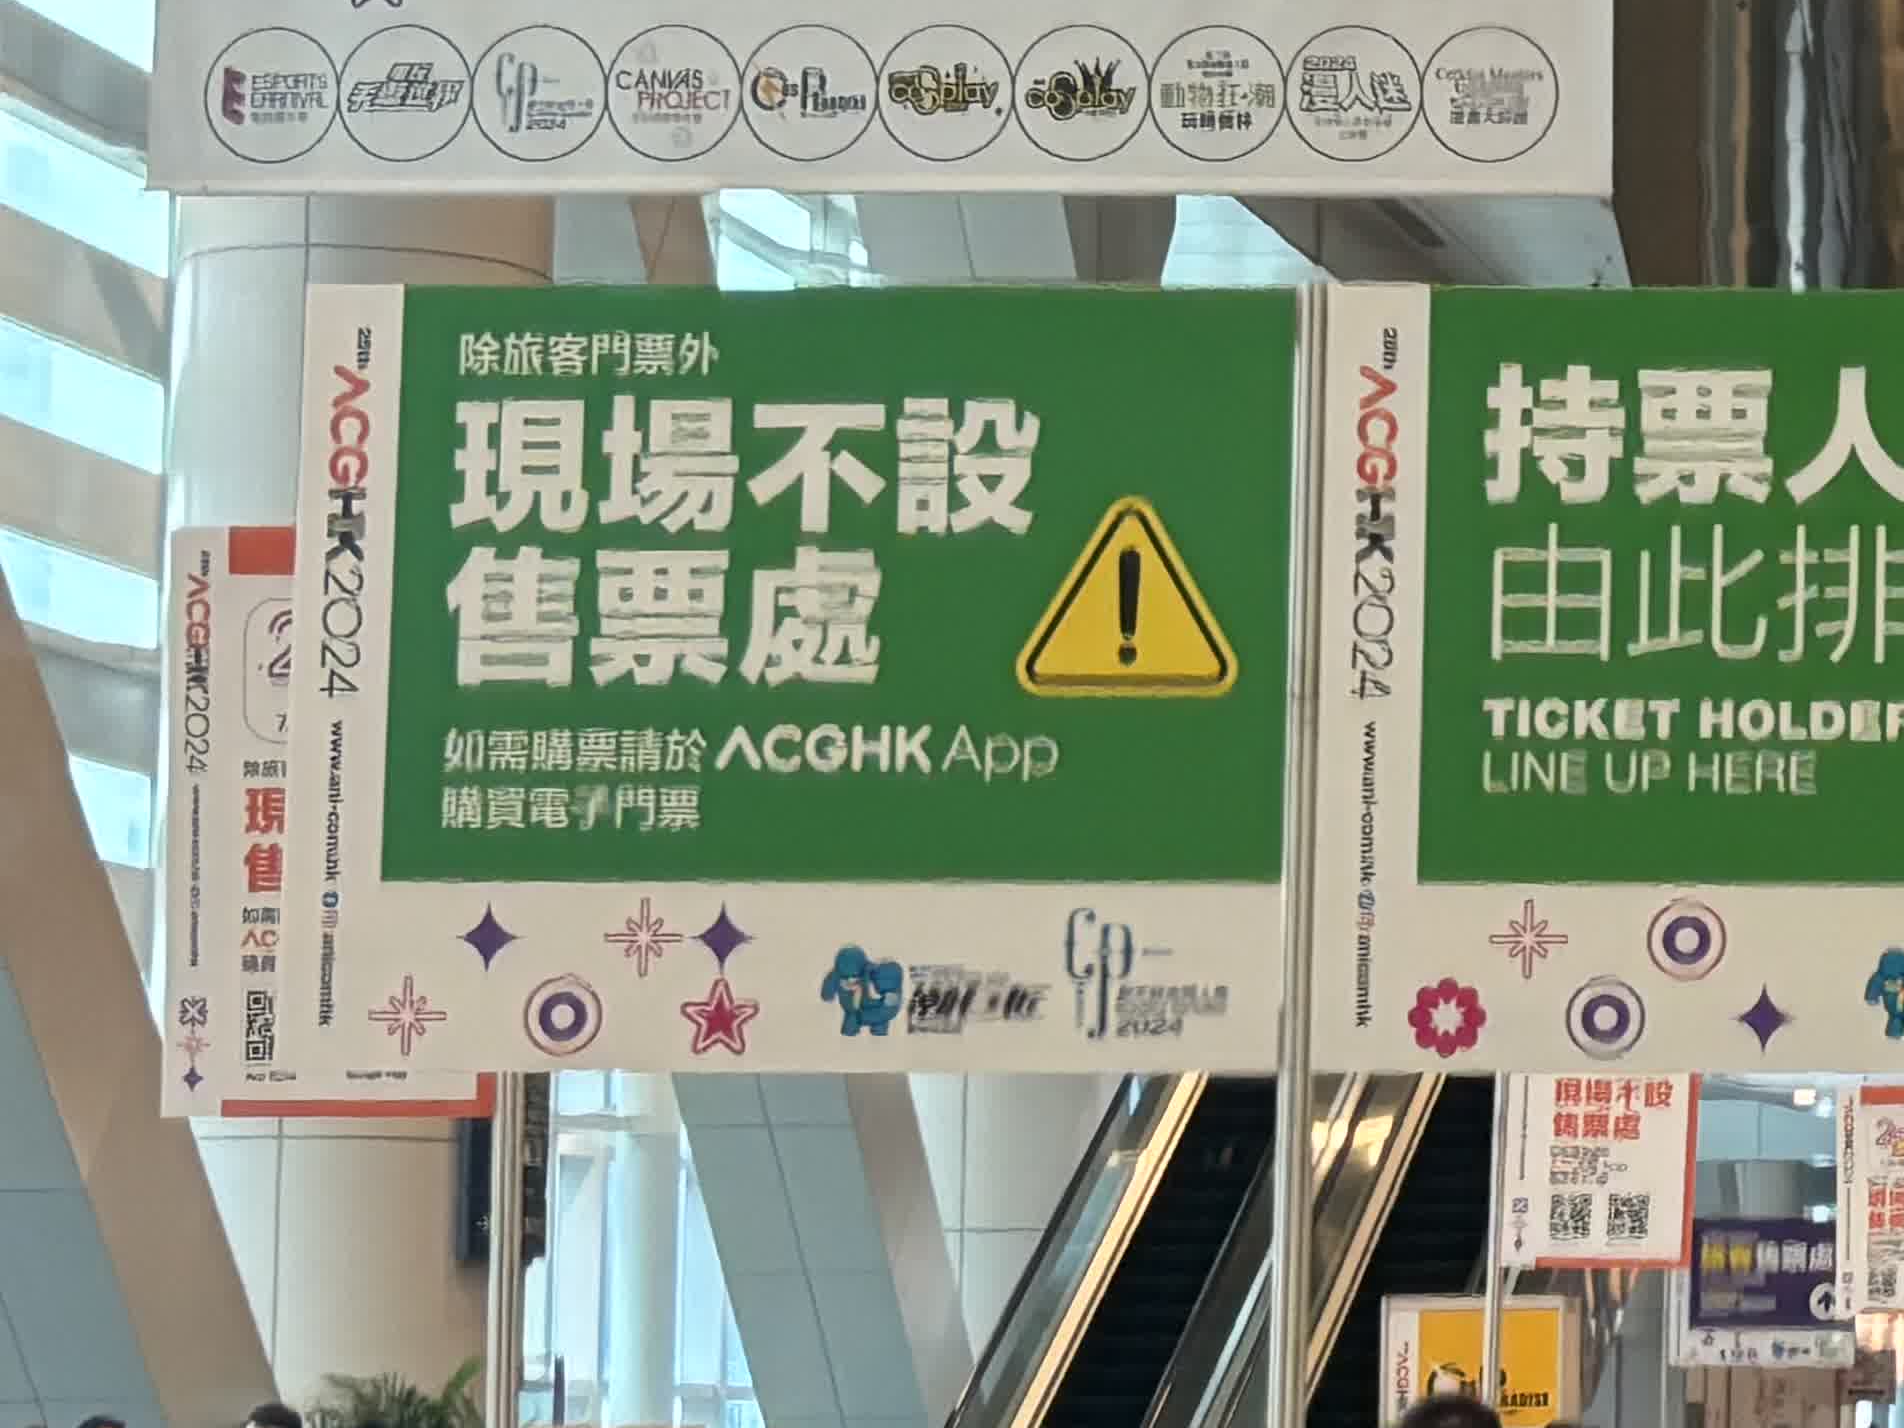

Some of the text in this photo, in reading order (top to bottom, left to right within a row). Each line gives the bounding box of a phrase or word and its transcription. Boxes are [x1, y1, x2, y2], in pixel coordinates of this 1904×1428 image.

[457, 330, 721, 379] 除旅客門票外
[448, 395, 1042, 537] 現場不設
[446, 546, 883, 690] 售票處
[1482, 697, 1681, 742] TICKET
[442, 722, 1060, 780] 如需購票請於 ACGHK App
[1481, 749, 1818, 795] LINE UP HERE
[440, 783, 702, 833] 購買電子門票
